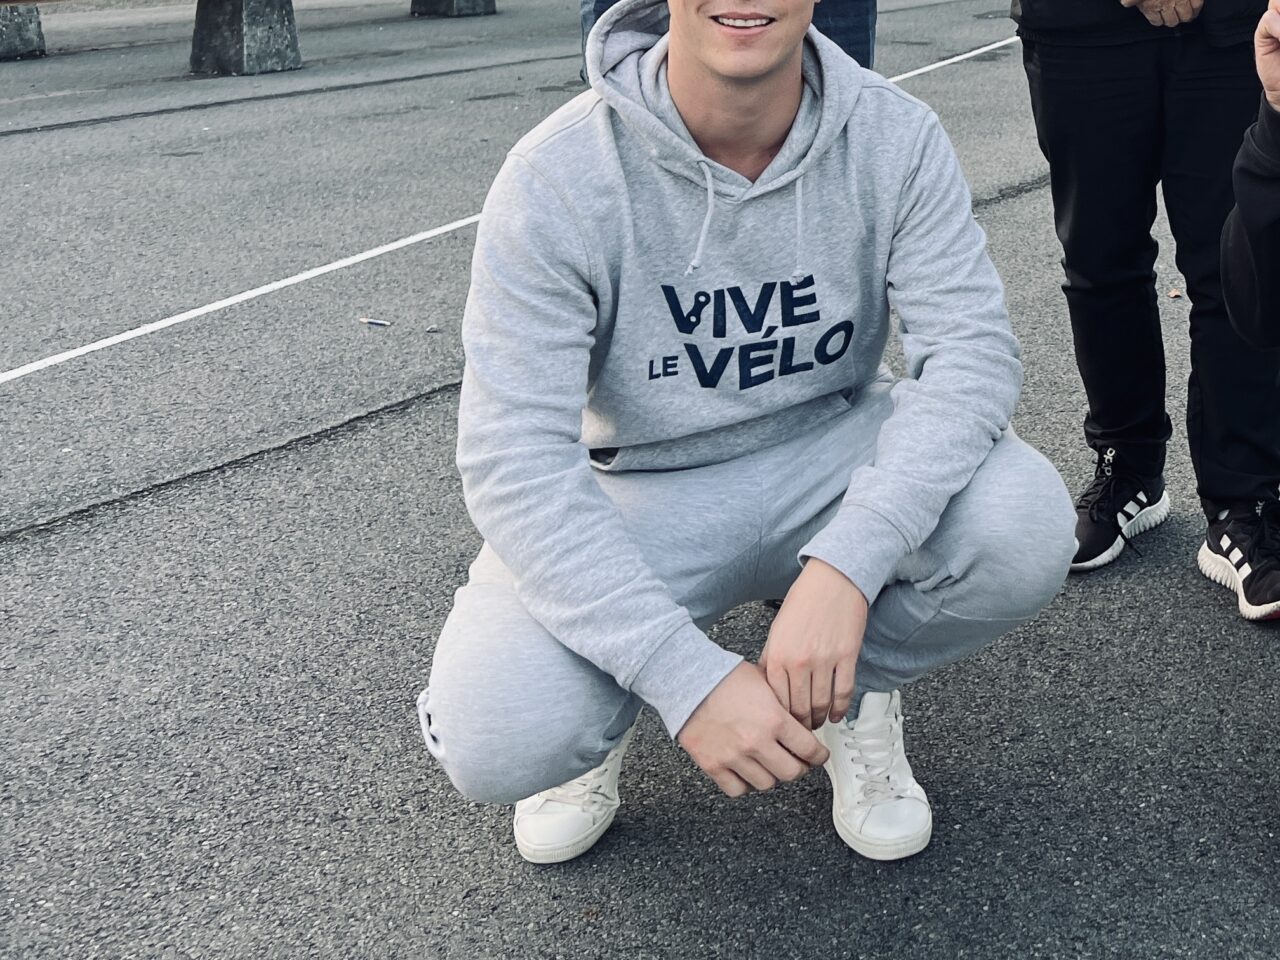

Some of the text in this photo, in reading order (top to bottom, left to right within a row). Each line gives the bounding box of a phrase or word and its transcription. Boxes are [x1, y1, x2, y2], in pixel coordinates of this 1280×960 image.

[661, 274, 820, 338] VIVE
[648, 320, 854, 390] LE VÉLO
